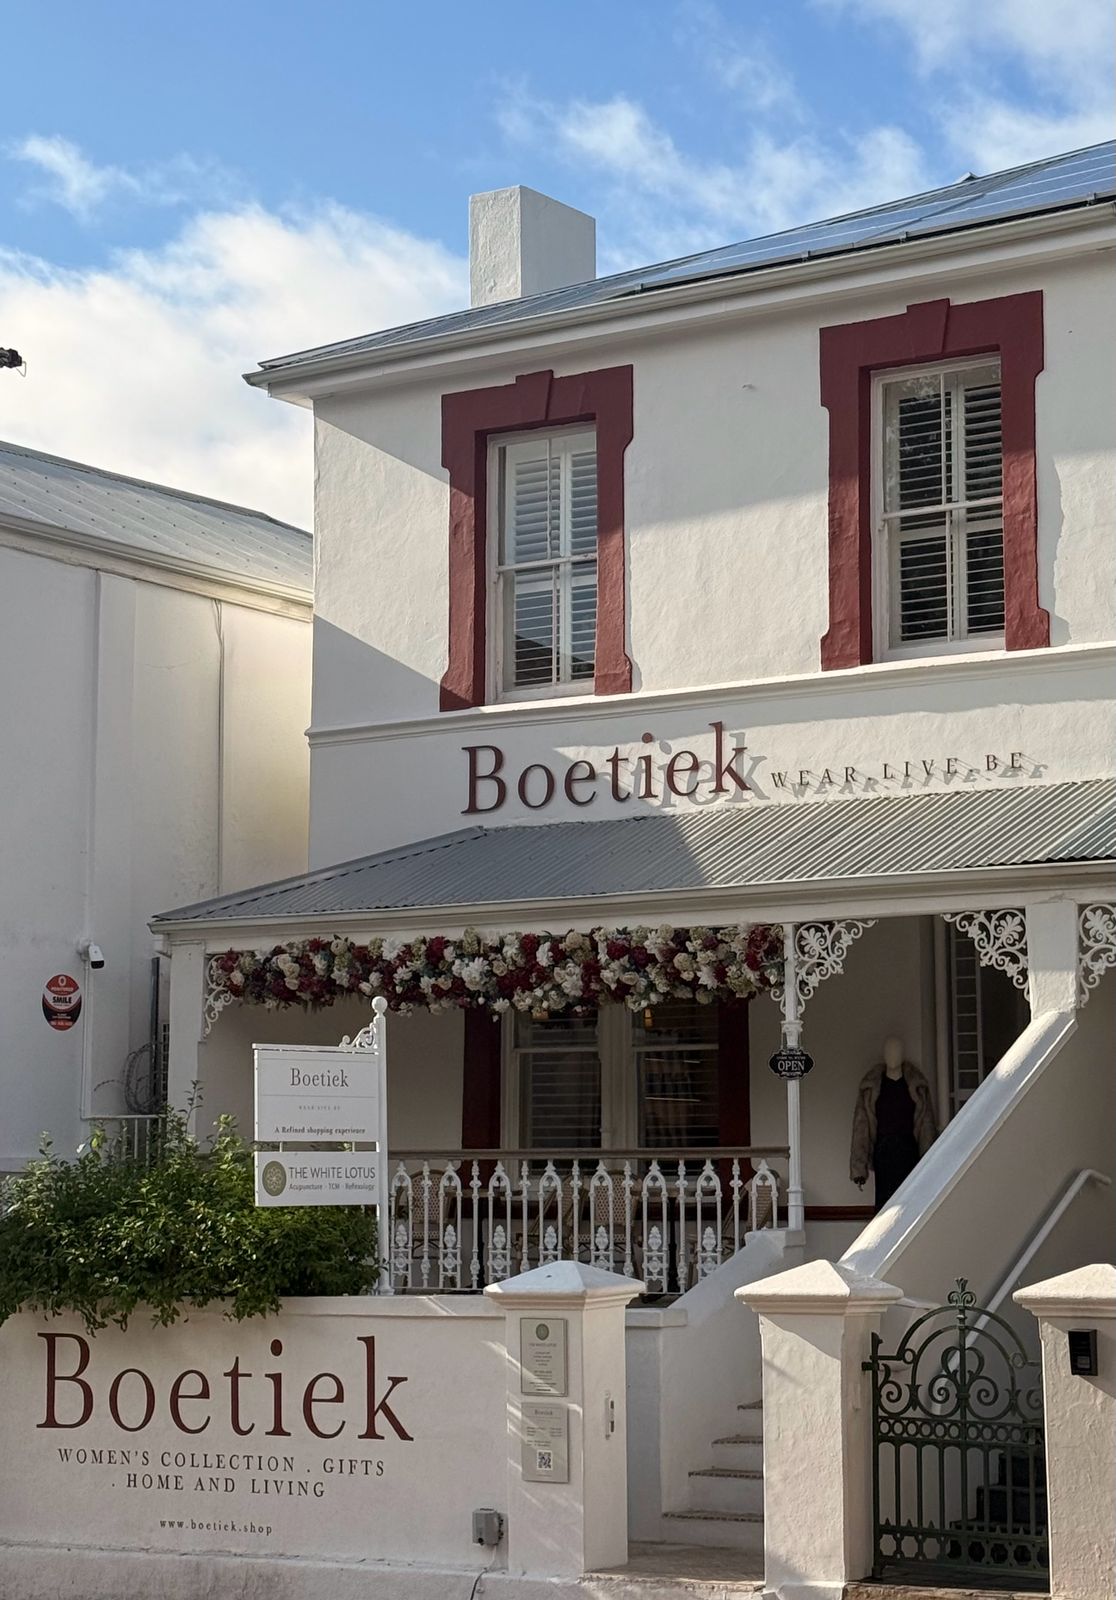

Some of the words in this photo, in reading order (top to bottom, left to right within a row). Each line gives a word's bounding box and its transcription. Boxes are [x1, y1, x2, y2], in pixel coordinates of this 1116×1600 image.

[461, 721, 754, 814] Boetiek
[52, 996, 72, 1004] SMILE
[777, 1060, 805, 1071] OPEN
[290, 1068, 349, 1088] Boetiek
[281, 1126, 305, 1134] Refined
[307, 1127, 333, 1135] shopping
[335, 1128, 366, 1136] experience
[289, 1166, 308, 1179] THE
[310, 1166, 342, 1179] WHITE
[345, 1166, 376, 1179] LOTUS
[289, 1183, 323, 1191] Acupuncture
[36, 1332, 414, 1441] Boetiek
[58, 1448, 150, 1466] WOMEN'S
[161, 1452, 295, 1472] COLLECTION
[323, 1458, 385, 1476] GIFTS
[126, 1473, 184, 1491] HOME
[194, 1476, 236, 1493] AND
[251, 1479, 325, 1498] LIVING
[160, 1519, 272, 1536] www.boetiek.shop
